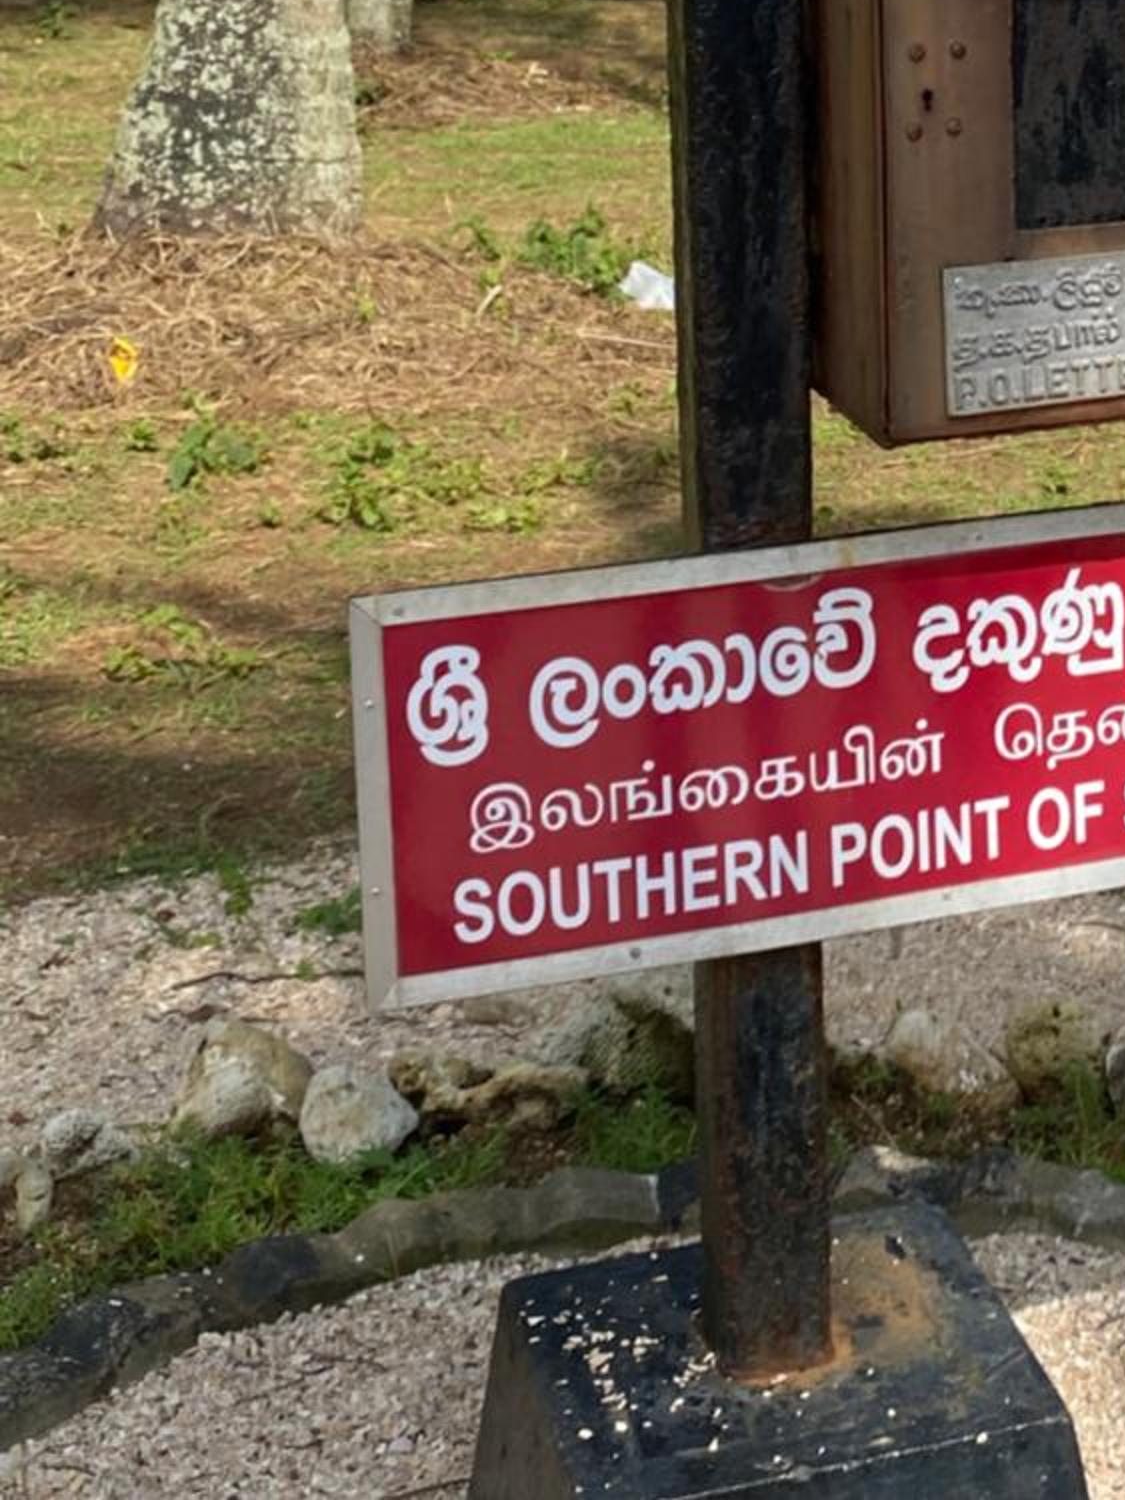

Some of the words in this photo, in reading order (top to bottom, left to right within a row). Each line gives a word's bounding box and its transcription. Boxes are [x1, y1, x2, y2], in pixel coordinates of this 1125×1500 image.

[405, 643, 491, 769] ශ්‍රී
[527, 586, 877, 750] ලංකාවේ
[911, 566, 1125, 693] දකුණු
[452, 829, 810, 946] SOUTHERN
[829, 794, 1011, 889] POINT
[1027, 779, 1106, 851] OF
[468, 717, 945, 855] இலங்கையின்
